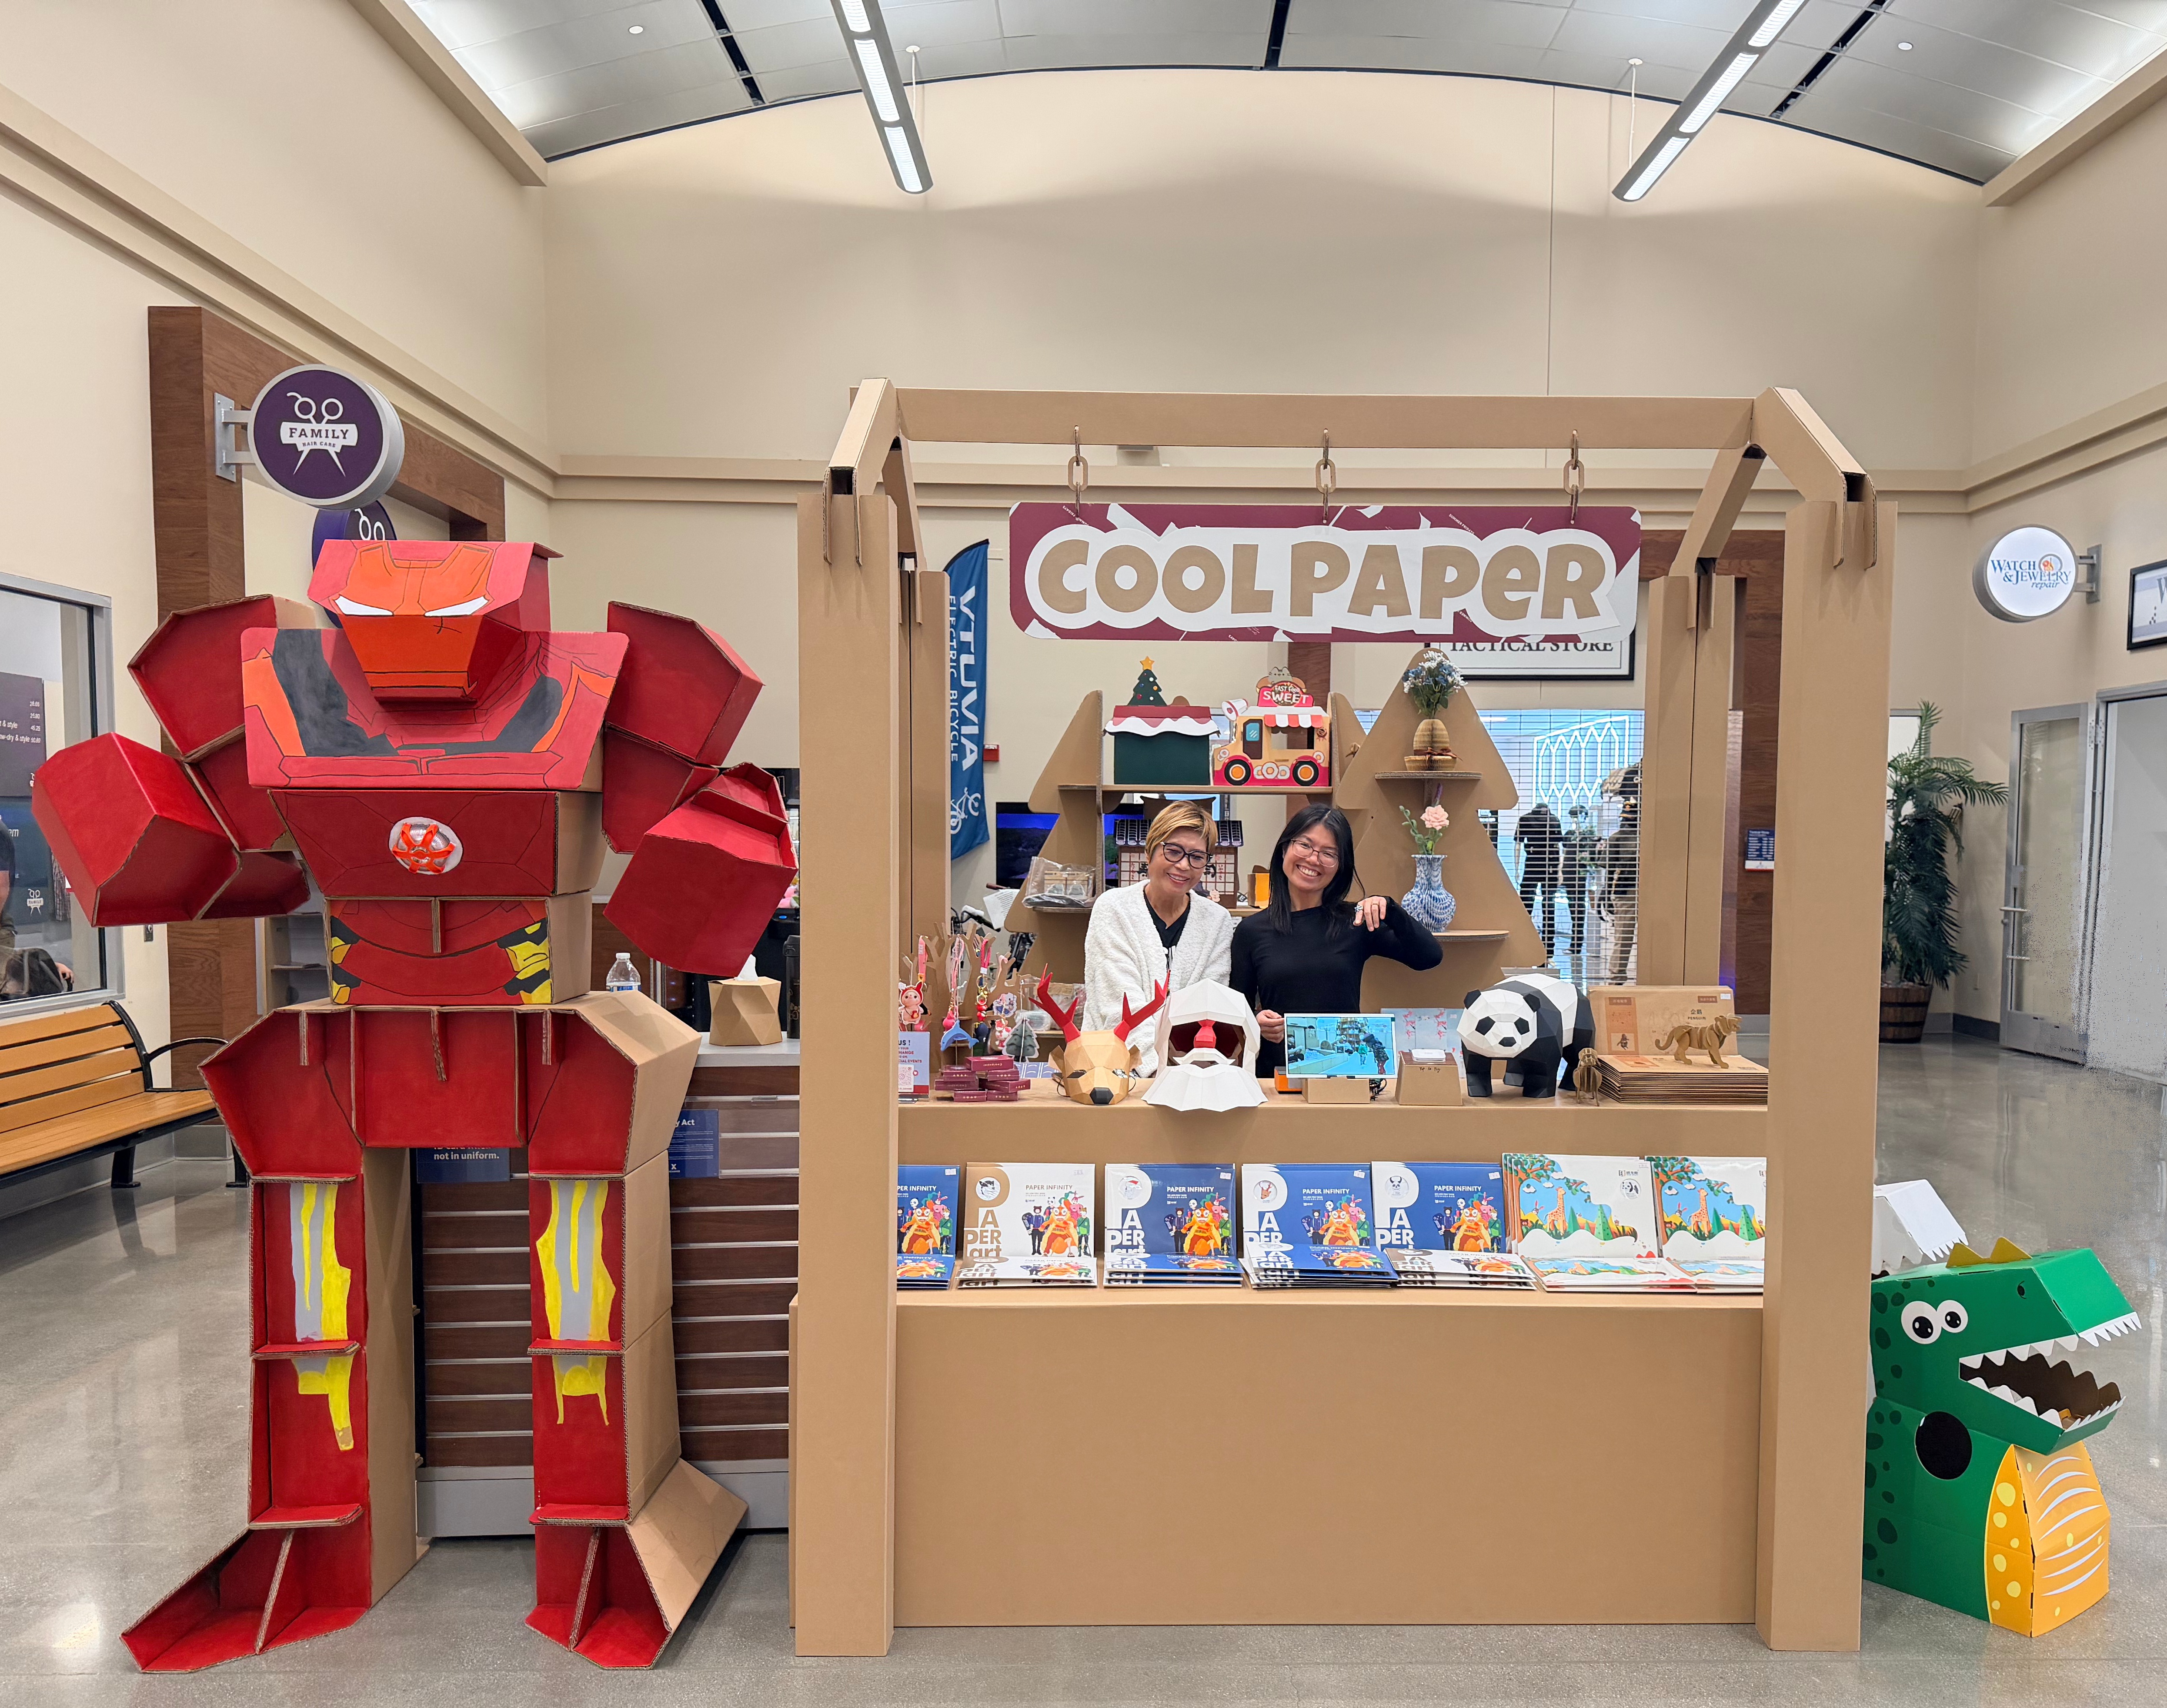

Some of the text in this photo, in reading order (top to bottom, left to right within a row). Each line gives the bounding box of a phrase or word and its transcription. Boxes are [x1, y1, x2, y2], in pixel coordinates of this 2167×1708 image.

[289, 427, 349, 439] FAMILY
[1990, 559, 2036, 574] WATCH
[1038, 538, 1274, 615] COOL
[2003, 570, 2071, 585] & JEWELRY
[2031, 582, 2060, 590] repair
[959, 585, 979, 772] VTUVIA
[1262, 691, 1309, 704] SWEET
[950, 690, 959, 762] BICYCLE
[451, 1151, 459, 1160] in
[461, 1151, 500, 1160] uniform.
